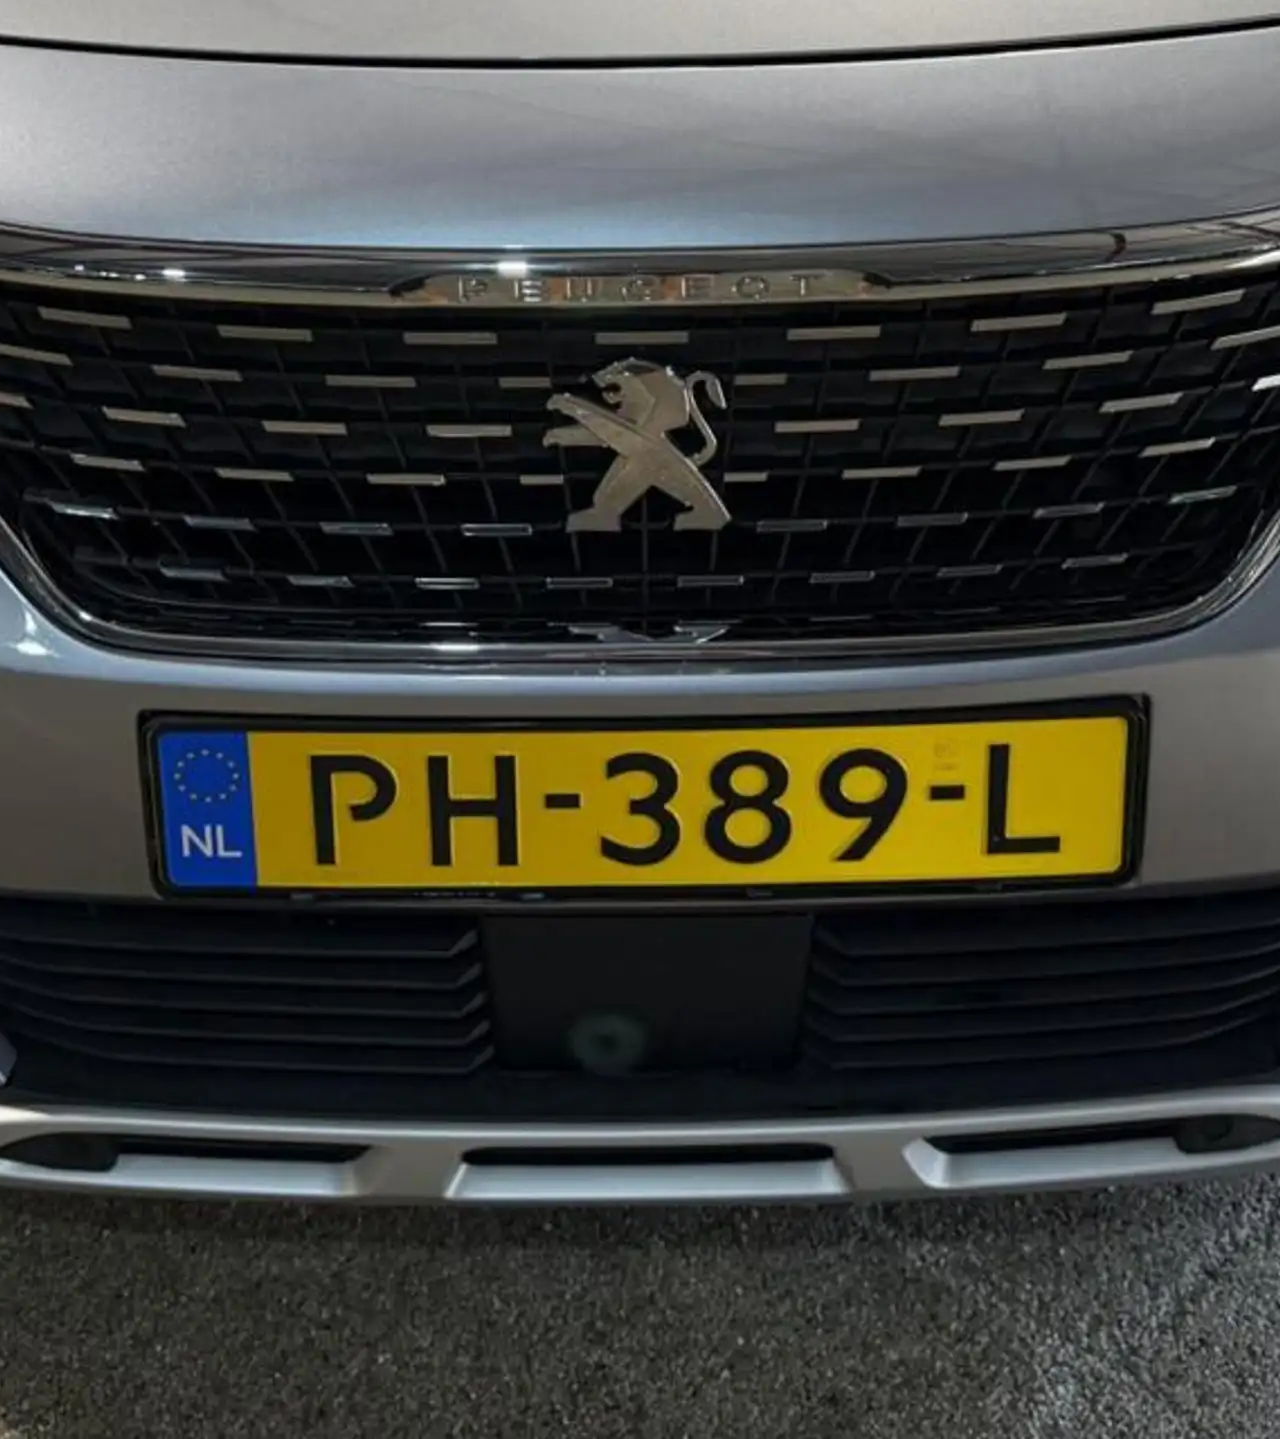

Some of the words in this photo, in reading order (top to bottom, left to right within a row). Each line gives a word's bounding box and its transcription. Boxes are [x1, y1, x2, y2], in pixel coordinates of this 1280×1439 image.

[458, 272, 824, 303] PEUGEOT
[181, 824, 243, 858] NL
[309, 743, 1061, 867] PH-389-L
